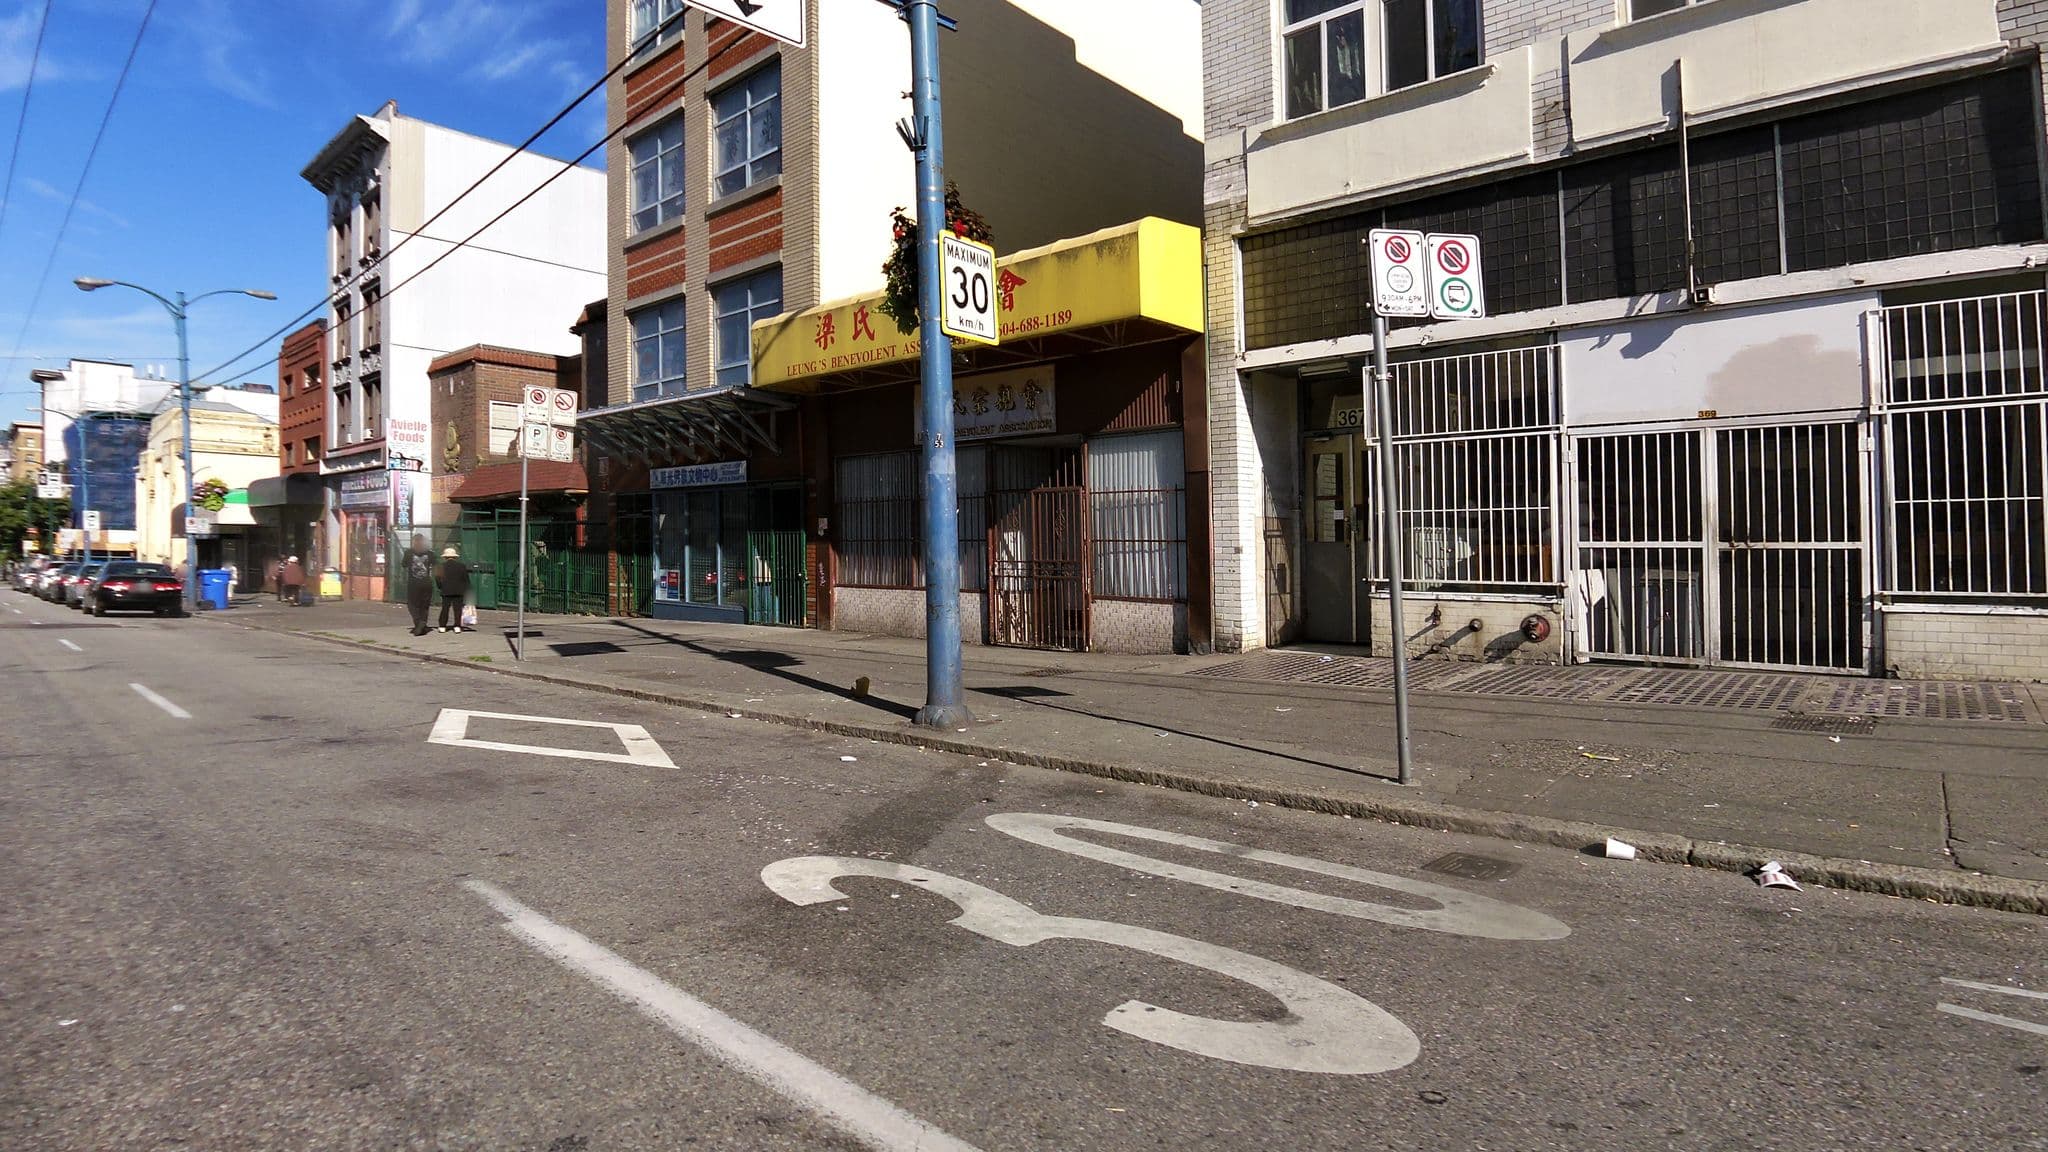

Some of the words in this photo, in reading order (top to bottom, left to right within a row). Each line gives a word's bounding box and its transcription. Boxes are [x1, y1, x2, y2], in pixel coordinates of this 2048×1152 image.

[947, 243, 990, 270] MAXIMUM
[952, 266, 989, 314] 30
[959, 316, 985, 331] km/h
[831, 345, 897, 369] BENEVOLENT
[390, 419, 428, 432] Avielle
[1338, 409, 1365, 426] 367
[393, 430, 425, 443] Foods
[533, 428, 541, 438] P
[760, 812, 1573, 1076] 30
